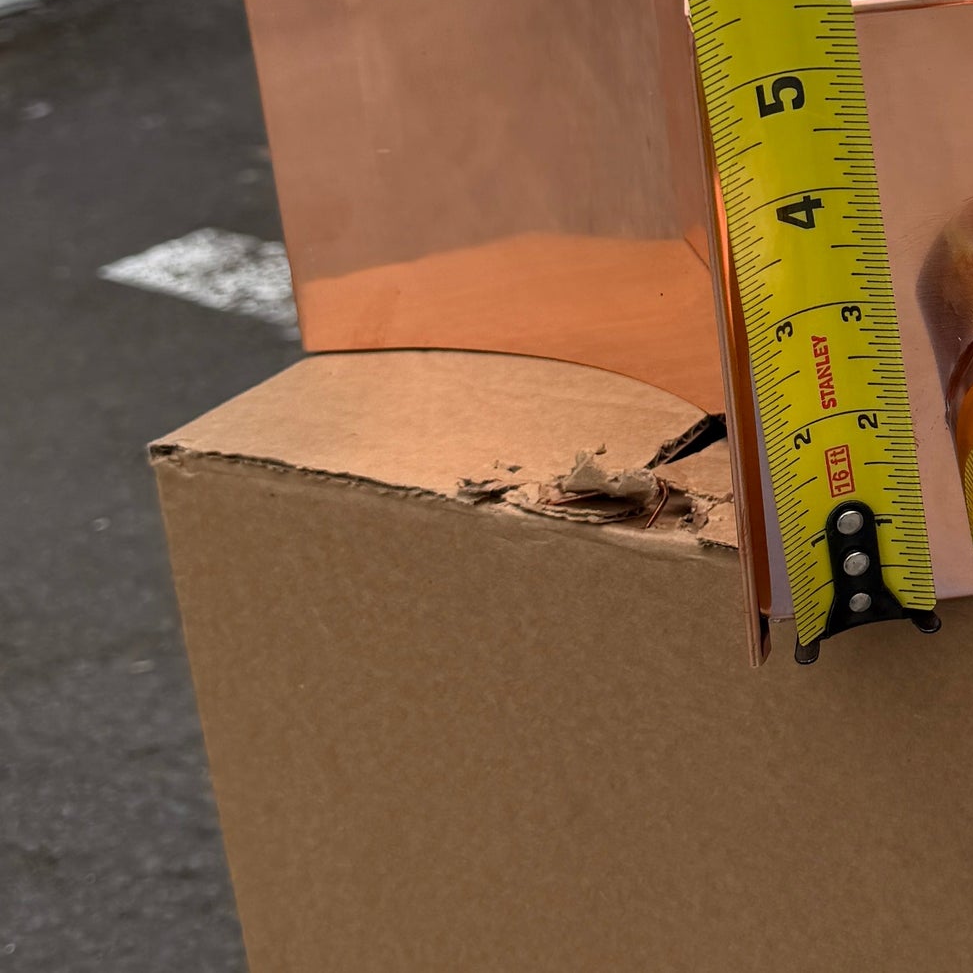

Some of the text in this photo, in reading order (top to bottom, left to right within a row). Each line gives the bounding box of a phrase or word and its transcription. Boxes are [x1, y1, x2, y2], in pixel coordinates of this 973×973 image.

[755, 75, 806, 119] 5
[776, 194, 825, 230] 4
[841, 305, 862, 322] 3
[775, 320, 793, 342] 3
[811, 335, 838, 409] STANLEY
[857, 413, 879, 429] 2
[793, 427, 812, 450] 2
[829, 448, 851, 493] 16 ft
